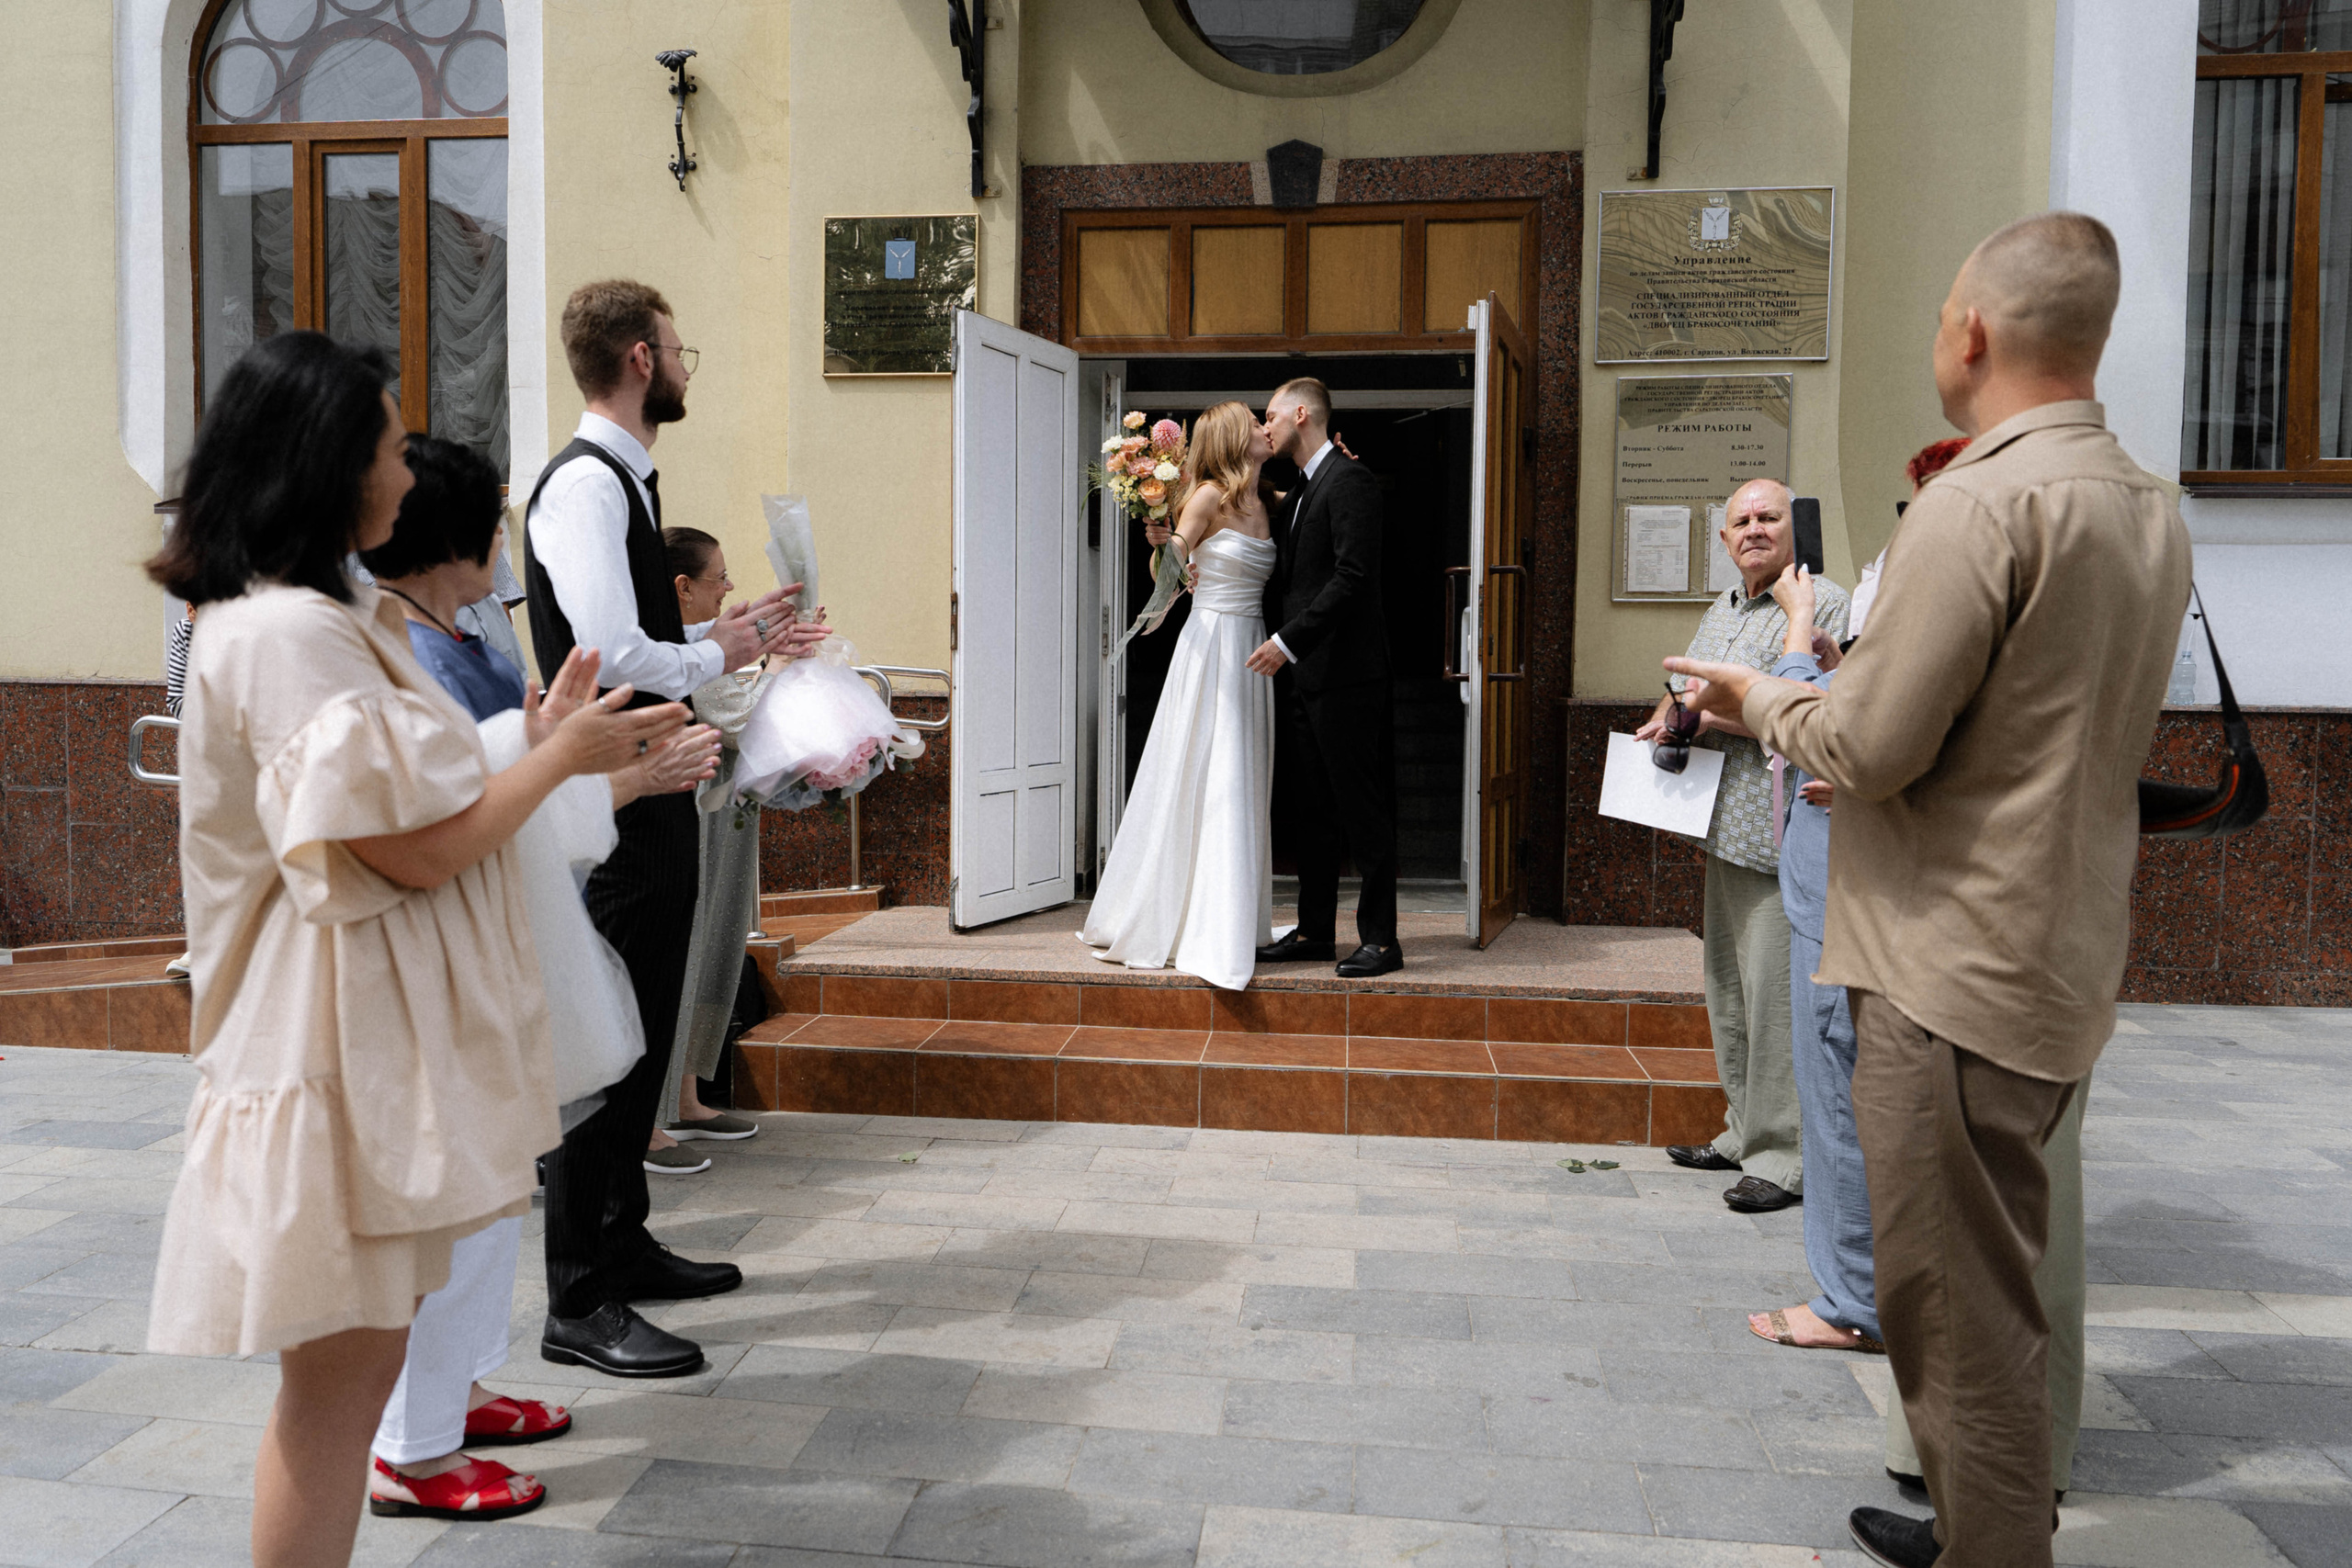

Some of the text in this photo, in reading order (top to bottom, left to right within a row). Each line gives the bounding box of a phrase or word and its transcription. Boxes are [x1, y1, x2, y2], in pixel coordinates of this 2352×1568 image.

[1674, 255, 1751, 266] Управление
[1636, 290, 1790, 300] СПЕЦИАЛИЗИРОВАННЫЙ ОТДЕЛ
[1631, 300, 1797, 310] ГОСУДАРСТВЕННОЙ РЕГИСТРАЦИИ
[1661, 310, 1738, 320] ГРАЖДАНСКОГО
[1687, 320, 1781, 328] БРАКОСОЧЕТАНИЙ»
[1627, 349, 1653, 357] Адрес:
[1657, 424, 1701, 433] РЕЖИМ
[1657, 445, 1684, 453] Суббота
